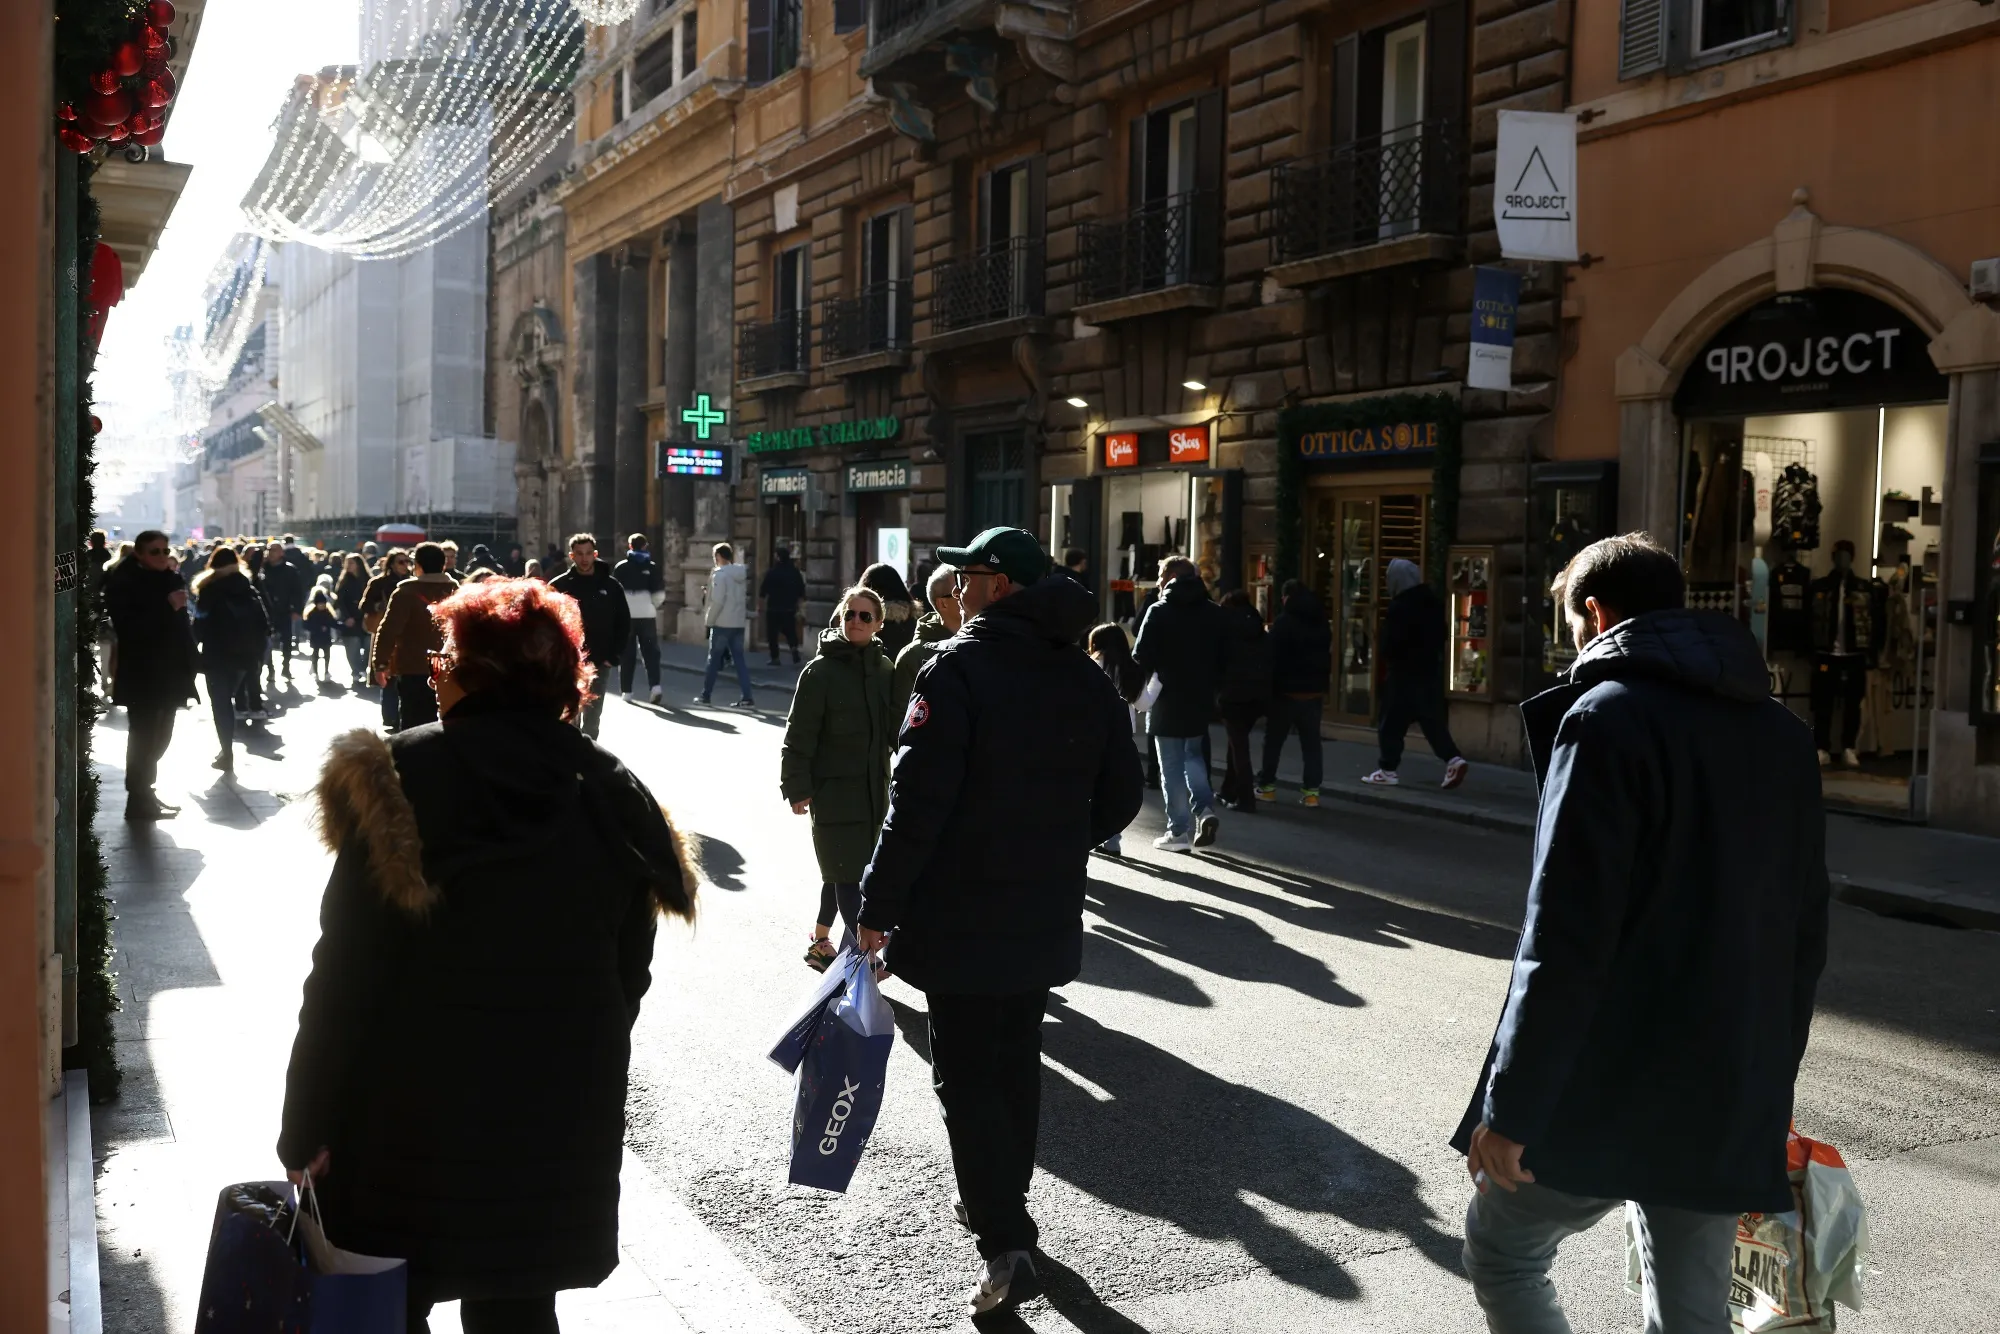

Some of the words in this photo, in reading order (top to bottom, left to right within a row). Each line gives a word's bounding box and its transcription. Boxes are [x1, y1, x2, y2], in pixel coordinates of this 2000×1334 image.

[1475, 299, 1515, 315] OTTICA
[1706, 328, 1900, 384] PROJECT
[1110, 439, 1133, 463] Gaia
[1170, 432, 1200, 455] Shoes
[1300, 428, 1376, 456] OTTICA
[1381, 422, 1438, 451] SOLE
[762, 472, 808, 493] Farmacia
[849, 464, 906, 488] Farmacia
[818, 1075, 861, 1156] GEOX
[1731, 1245, 1781, 1305] LANE
